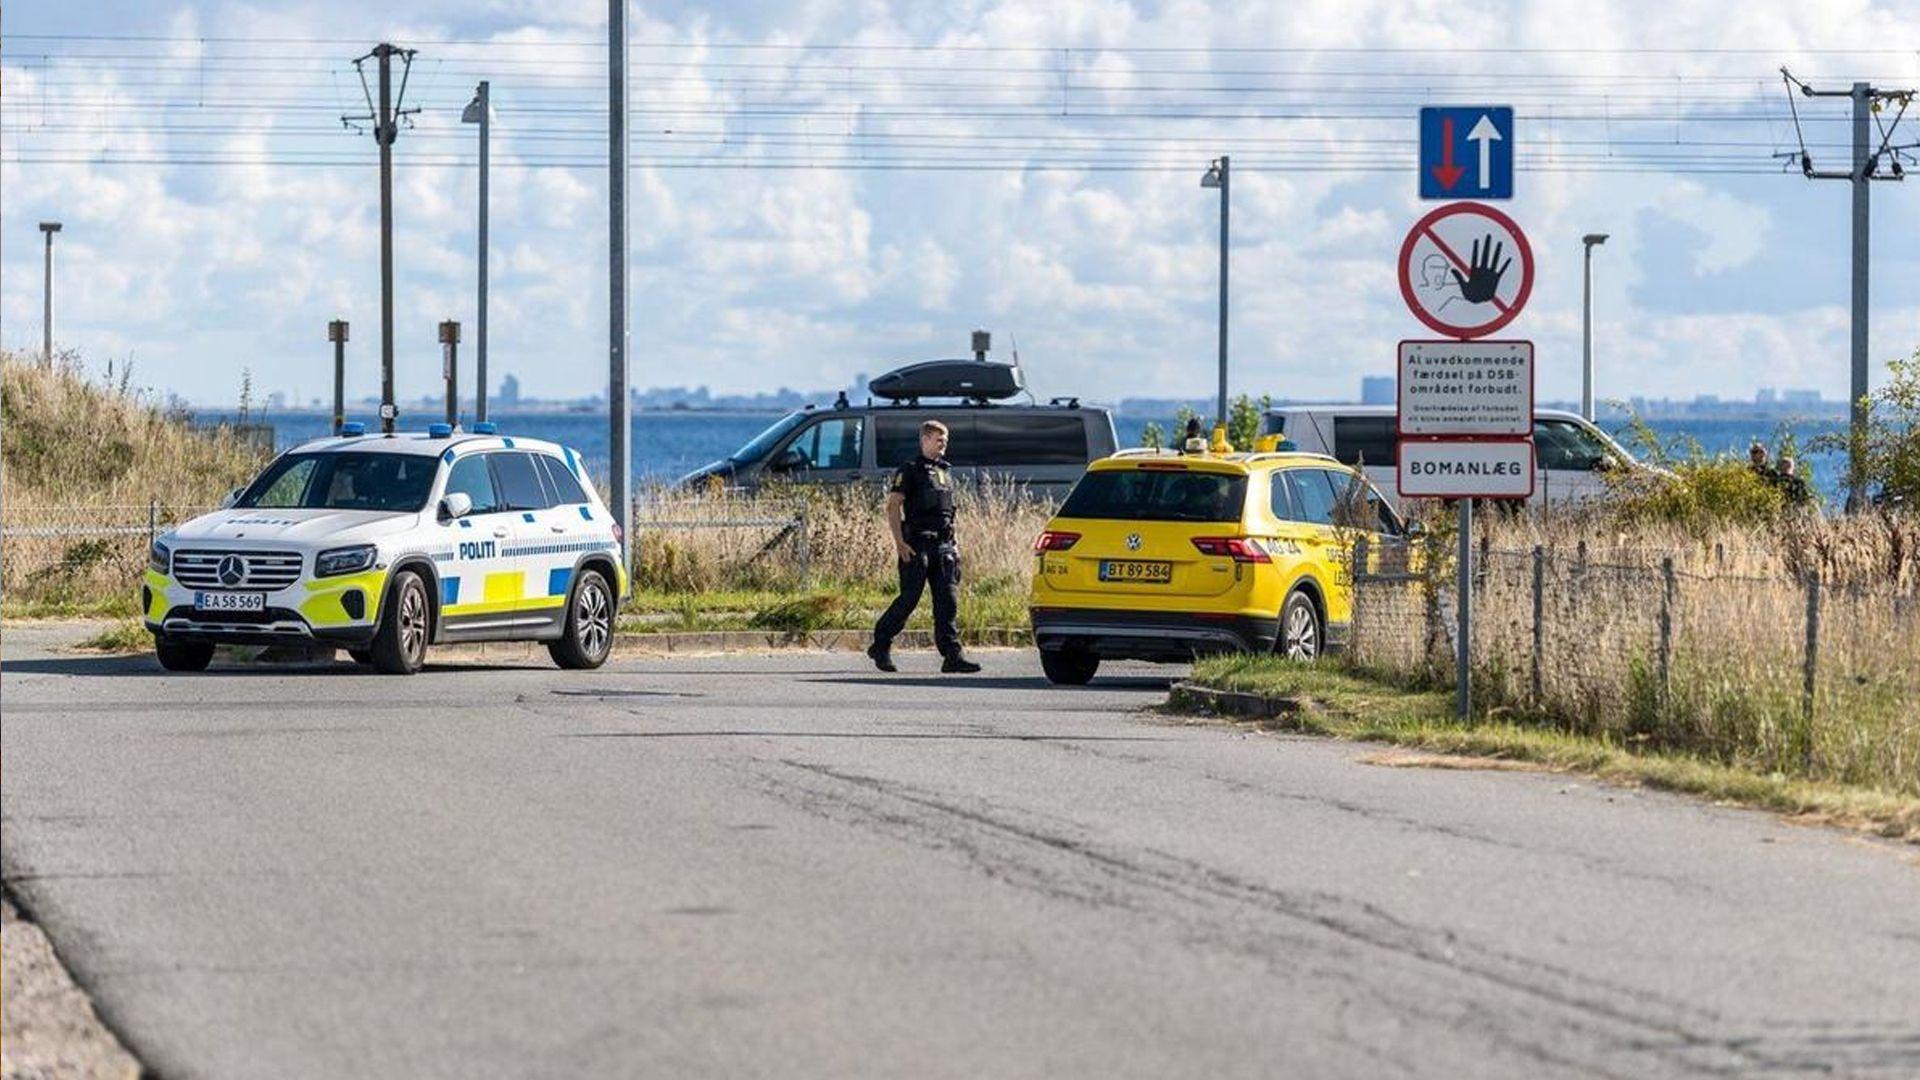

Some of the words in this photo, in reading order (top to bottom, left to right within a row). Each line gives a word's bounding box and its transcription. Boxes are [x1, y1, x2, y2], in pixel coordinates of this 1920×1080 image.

[1425, 355, 1525, 365] uvedkommende
[1413, 369, 1464, 380] færdsel
[1467, 369, 1482, 381] på
[1409, 383, 1463, 394] området
[1467, 383, 1522, 394] forbudt.
[1410, 461, 1521, 476] BOMANLÆG
[459, 541, 496, 561] POLITI
[1108, 562, 1125, 576] BT
[1127, 563, 1143, 577] 89
[1145, 564, 1169, 578] 584
[204, 595, 220, 608] EA
[222, 596, 237, 608] 58
[239, 596, 261, 609] 569
